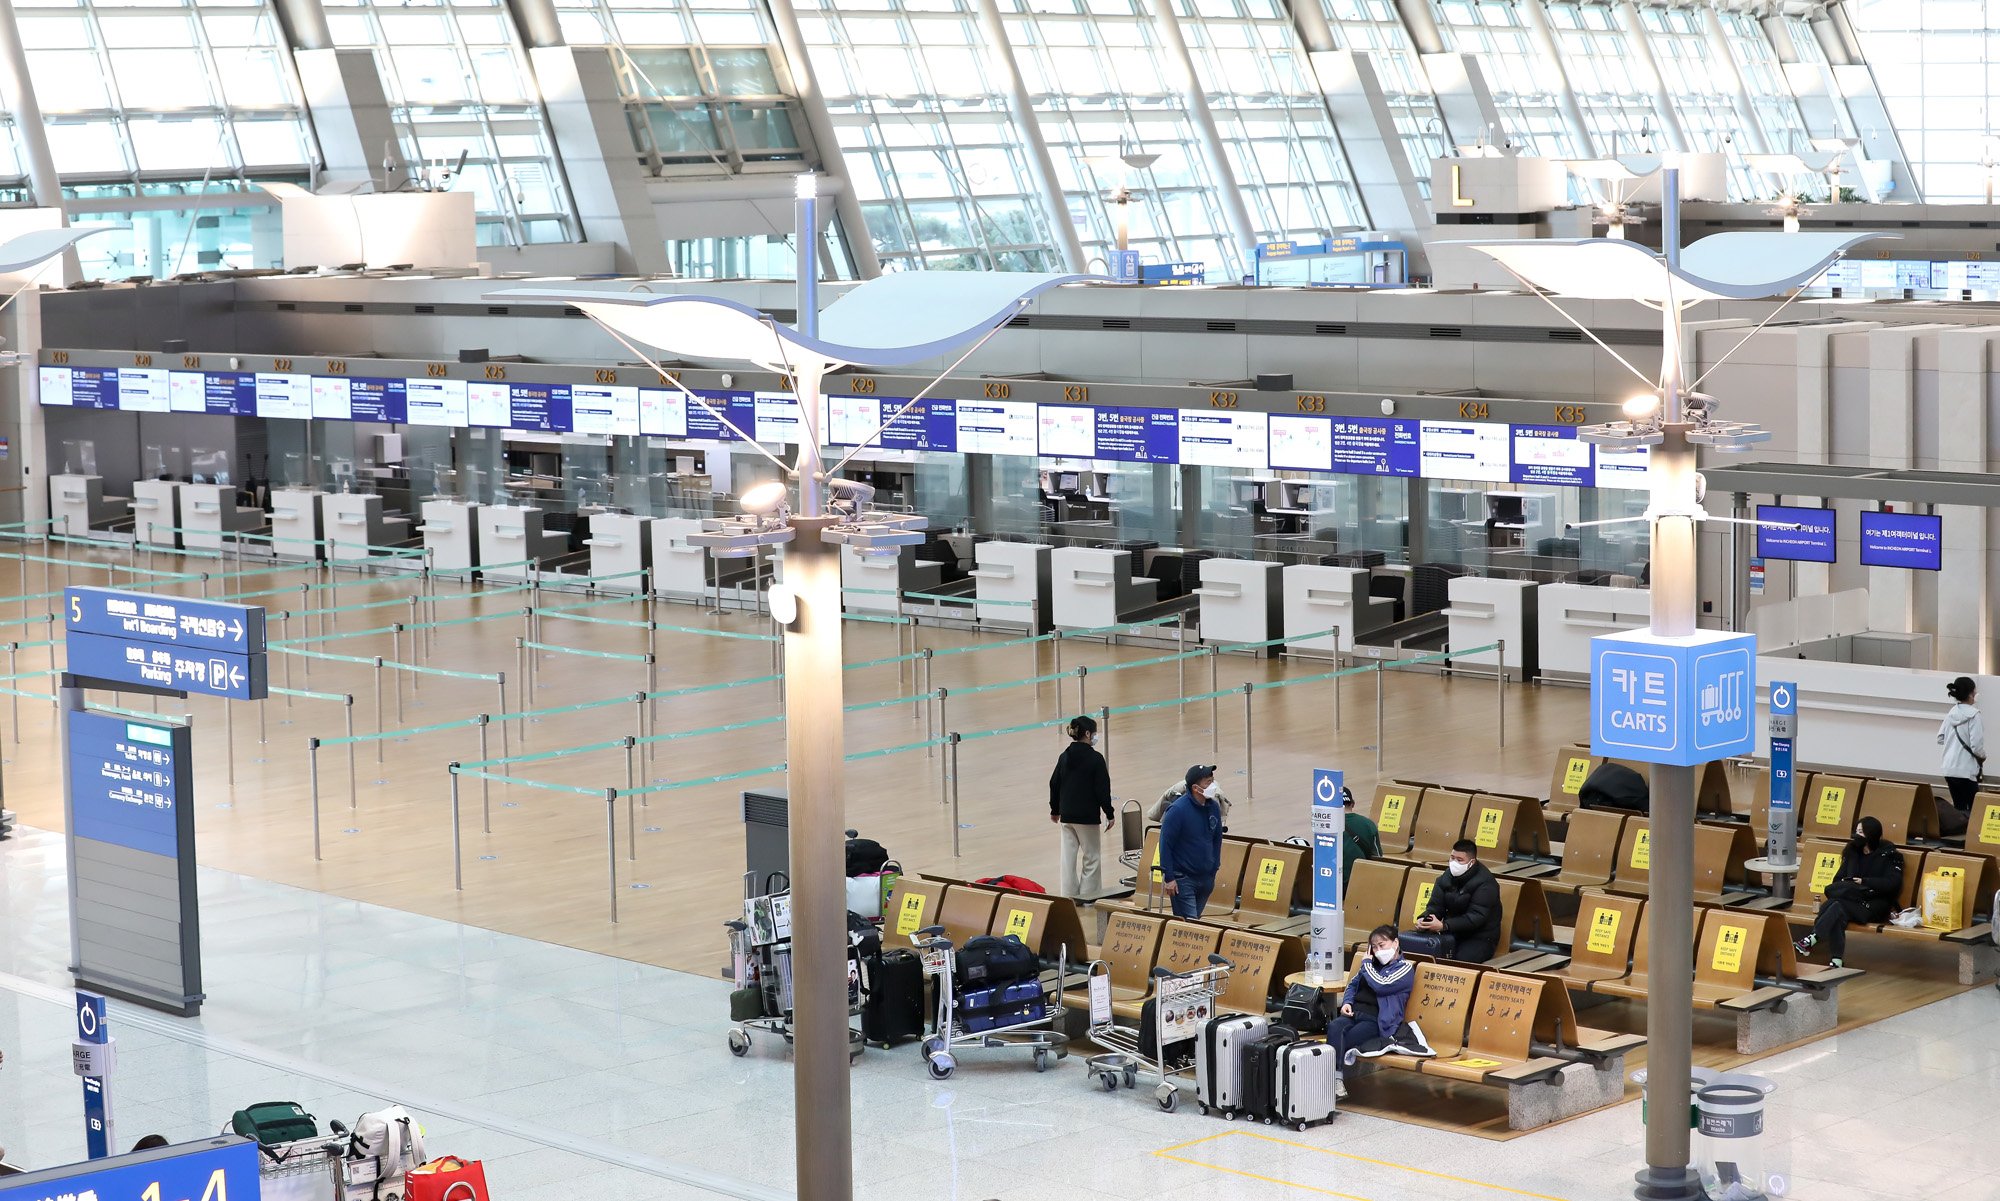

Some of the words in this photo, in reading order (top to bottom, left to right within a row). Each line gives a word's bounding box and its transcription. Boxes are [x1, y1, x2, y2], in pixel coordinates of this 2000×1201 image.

[1452, 165, 1474, 207] L
[1876, 251, 1890, 259] L23
[1966, 252, 1981, 260] L24
[53, 352, 68, 364] K19
[134, 355, 151, 367] K20
[183, 357, 200, 368] K21
[273, 359, 292, 372] K22
[327, 361, 345, 373] K23
[427, 364, 446, 377] K24
[485, 366, 504, 379] K25
[595, 370, 616, 383] K26
[781, 376, 798, 390] K2
[851, 378, 875, 393] K29
[984, 383, 1009, 398] K30
[1064, 386, 1088, 401] K31
[1210, 392, 1238, 408] K32
[1297, 396, 1325, 412] K33
[1459, 402, 1489, 419] K34
[1554, 406, 1585, 423] K35
[1335, 424, 1346, 433] 3번,
[1348, 424, 1358, 434] 5번
[1866, 529, 1881, 537] 여기는
[1919, 532, 1936, 540] 입니다.
[71, 596, 82, 622] 5
[140, 621, 177, 640] Boarding
[141, 666, 172, 685] Parking
[175, 659, 205, 682] 주차장
[213, 664, 224, 685] P
[1612, 669, 1667, 705] 카트
[1611, 711, 1667, 733] CARTS
[1933, 915, 1949, 923] SAVE
[1116, 920, 1152, 933] 교통약자배려석
[1172, 928, 1210, 943] 교통약자배려석
[1230, 939, 1271, 953] 교통약자배려석
[1231, 951, 1250, 959] PRIORITY
[1250, 954, 1264, 962] SEATS
[1424, 971, 1466, 985] 교통약자배려석
[1424, 984, 1444, 992] PRIORITY
[1489, 980, 1532, 995] 교통약자배려석
[1489, 993, 1510, 1002] PRIORITY
[1511, 996, 1525, 1004] SEATS
